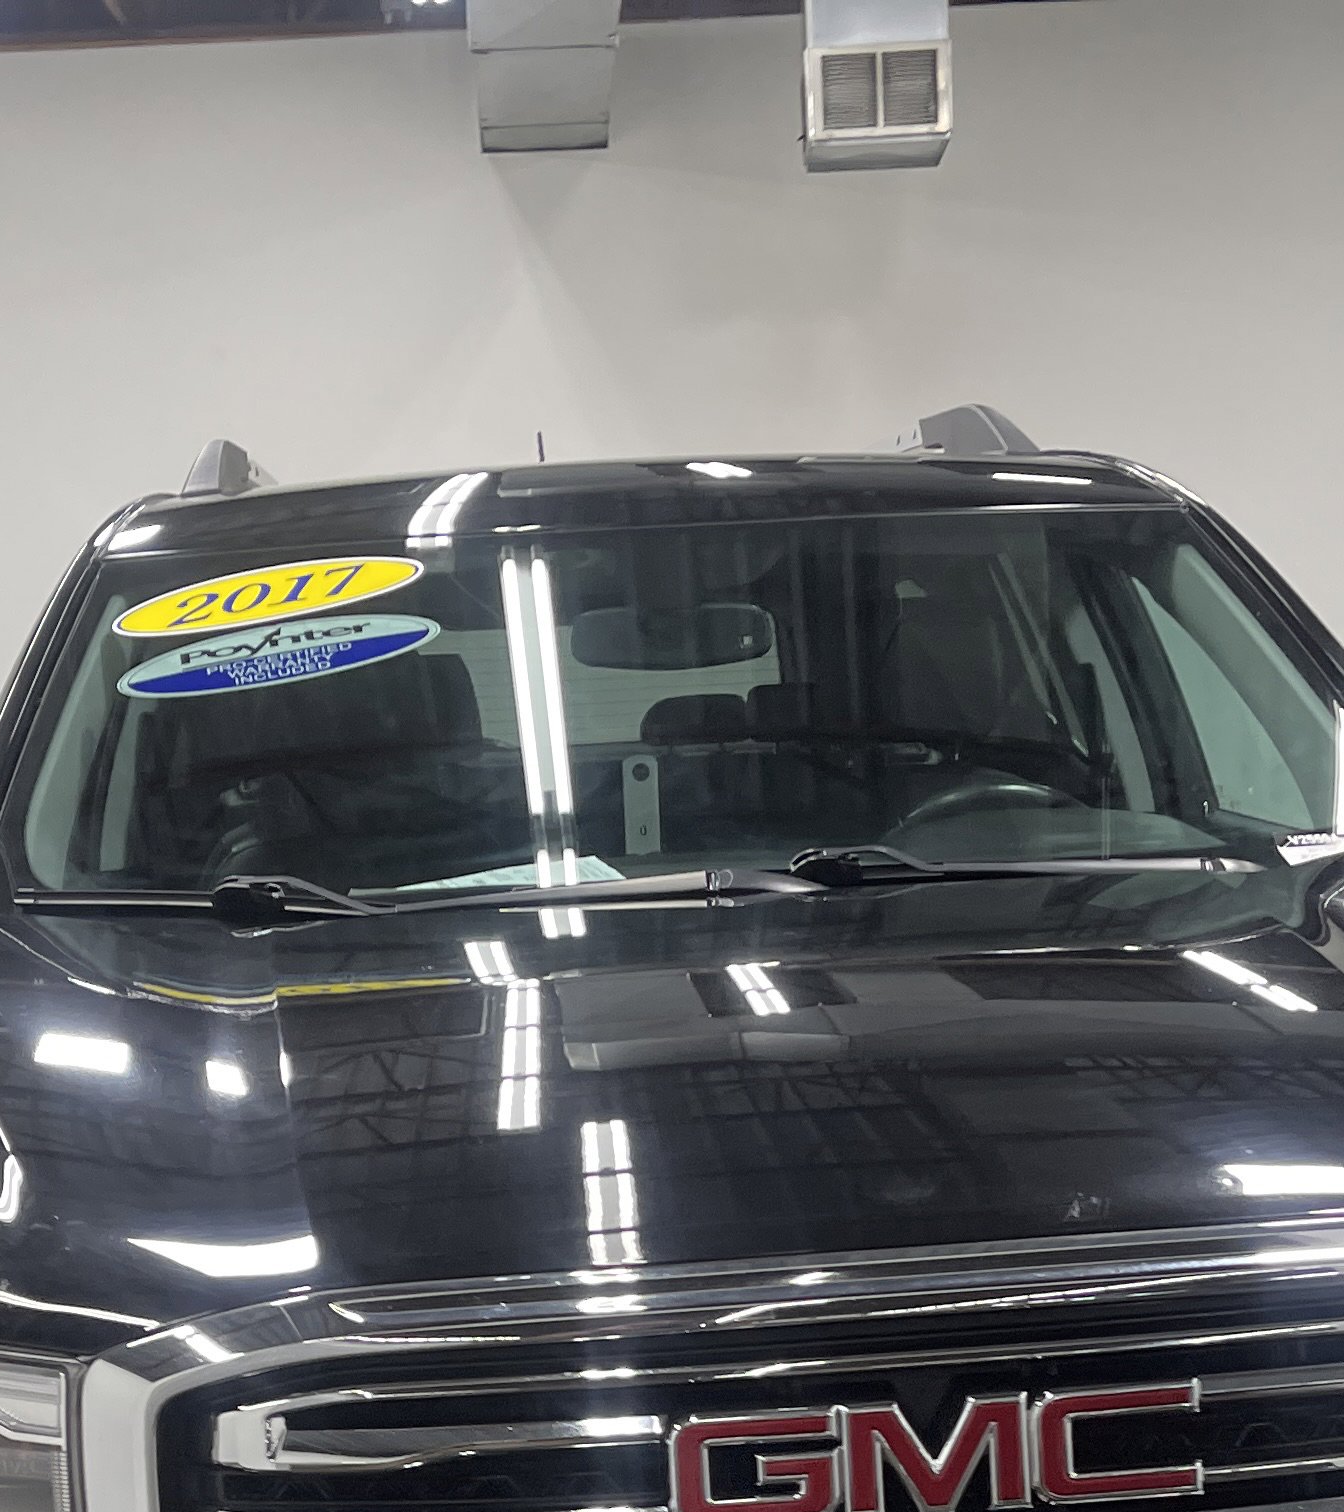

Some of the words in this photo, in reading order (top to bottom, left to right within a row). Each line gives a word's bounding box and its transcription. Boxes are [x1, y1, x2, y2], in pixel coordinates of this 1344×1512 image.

[167, 563, 365, 627] 2017
[227, 653, 333, 679] WARRANTY
[235, 661, 331, 686] INCLUDED
